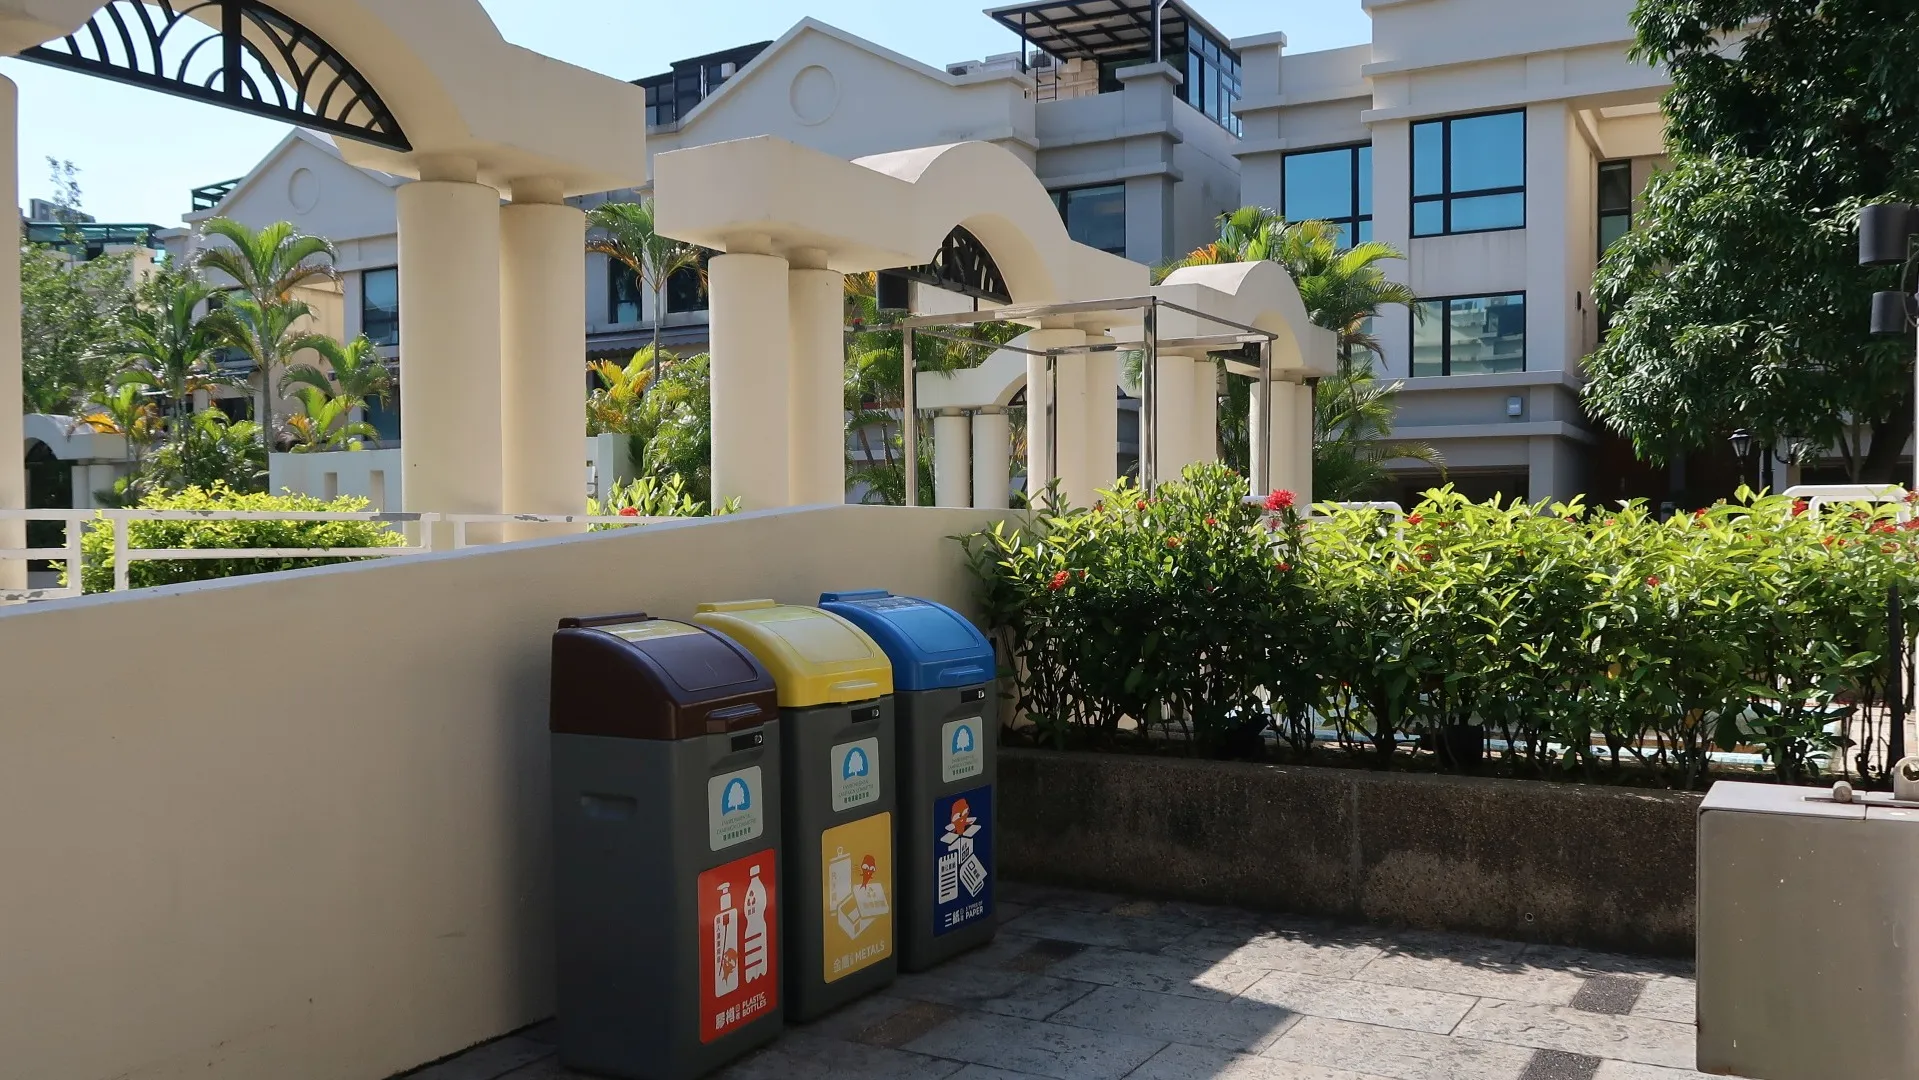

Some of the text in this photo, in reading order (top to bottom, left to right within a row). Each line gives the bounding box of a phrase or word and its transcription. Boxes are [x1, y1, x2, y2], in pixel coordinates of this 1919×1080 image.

[965, 905, 984, 920] PAPER
[855, 940, 885, 963] METALS
[742, 991, 765, 1010] PLASTIC
[742, 998, 767, 1017] BOTTLES
